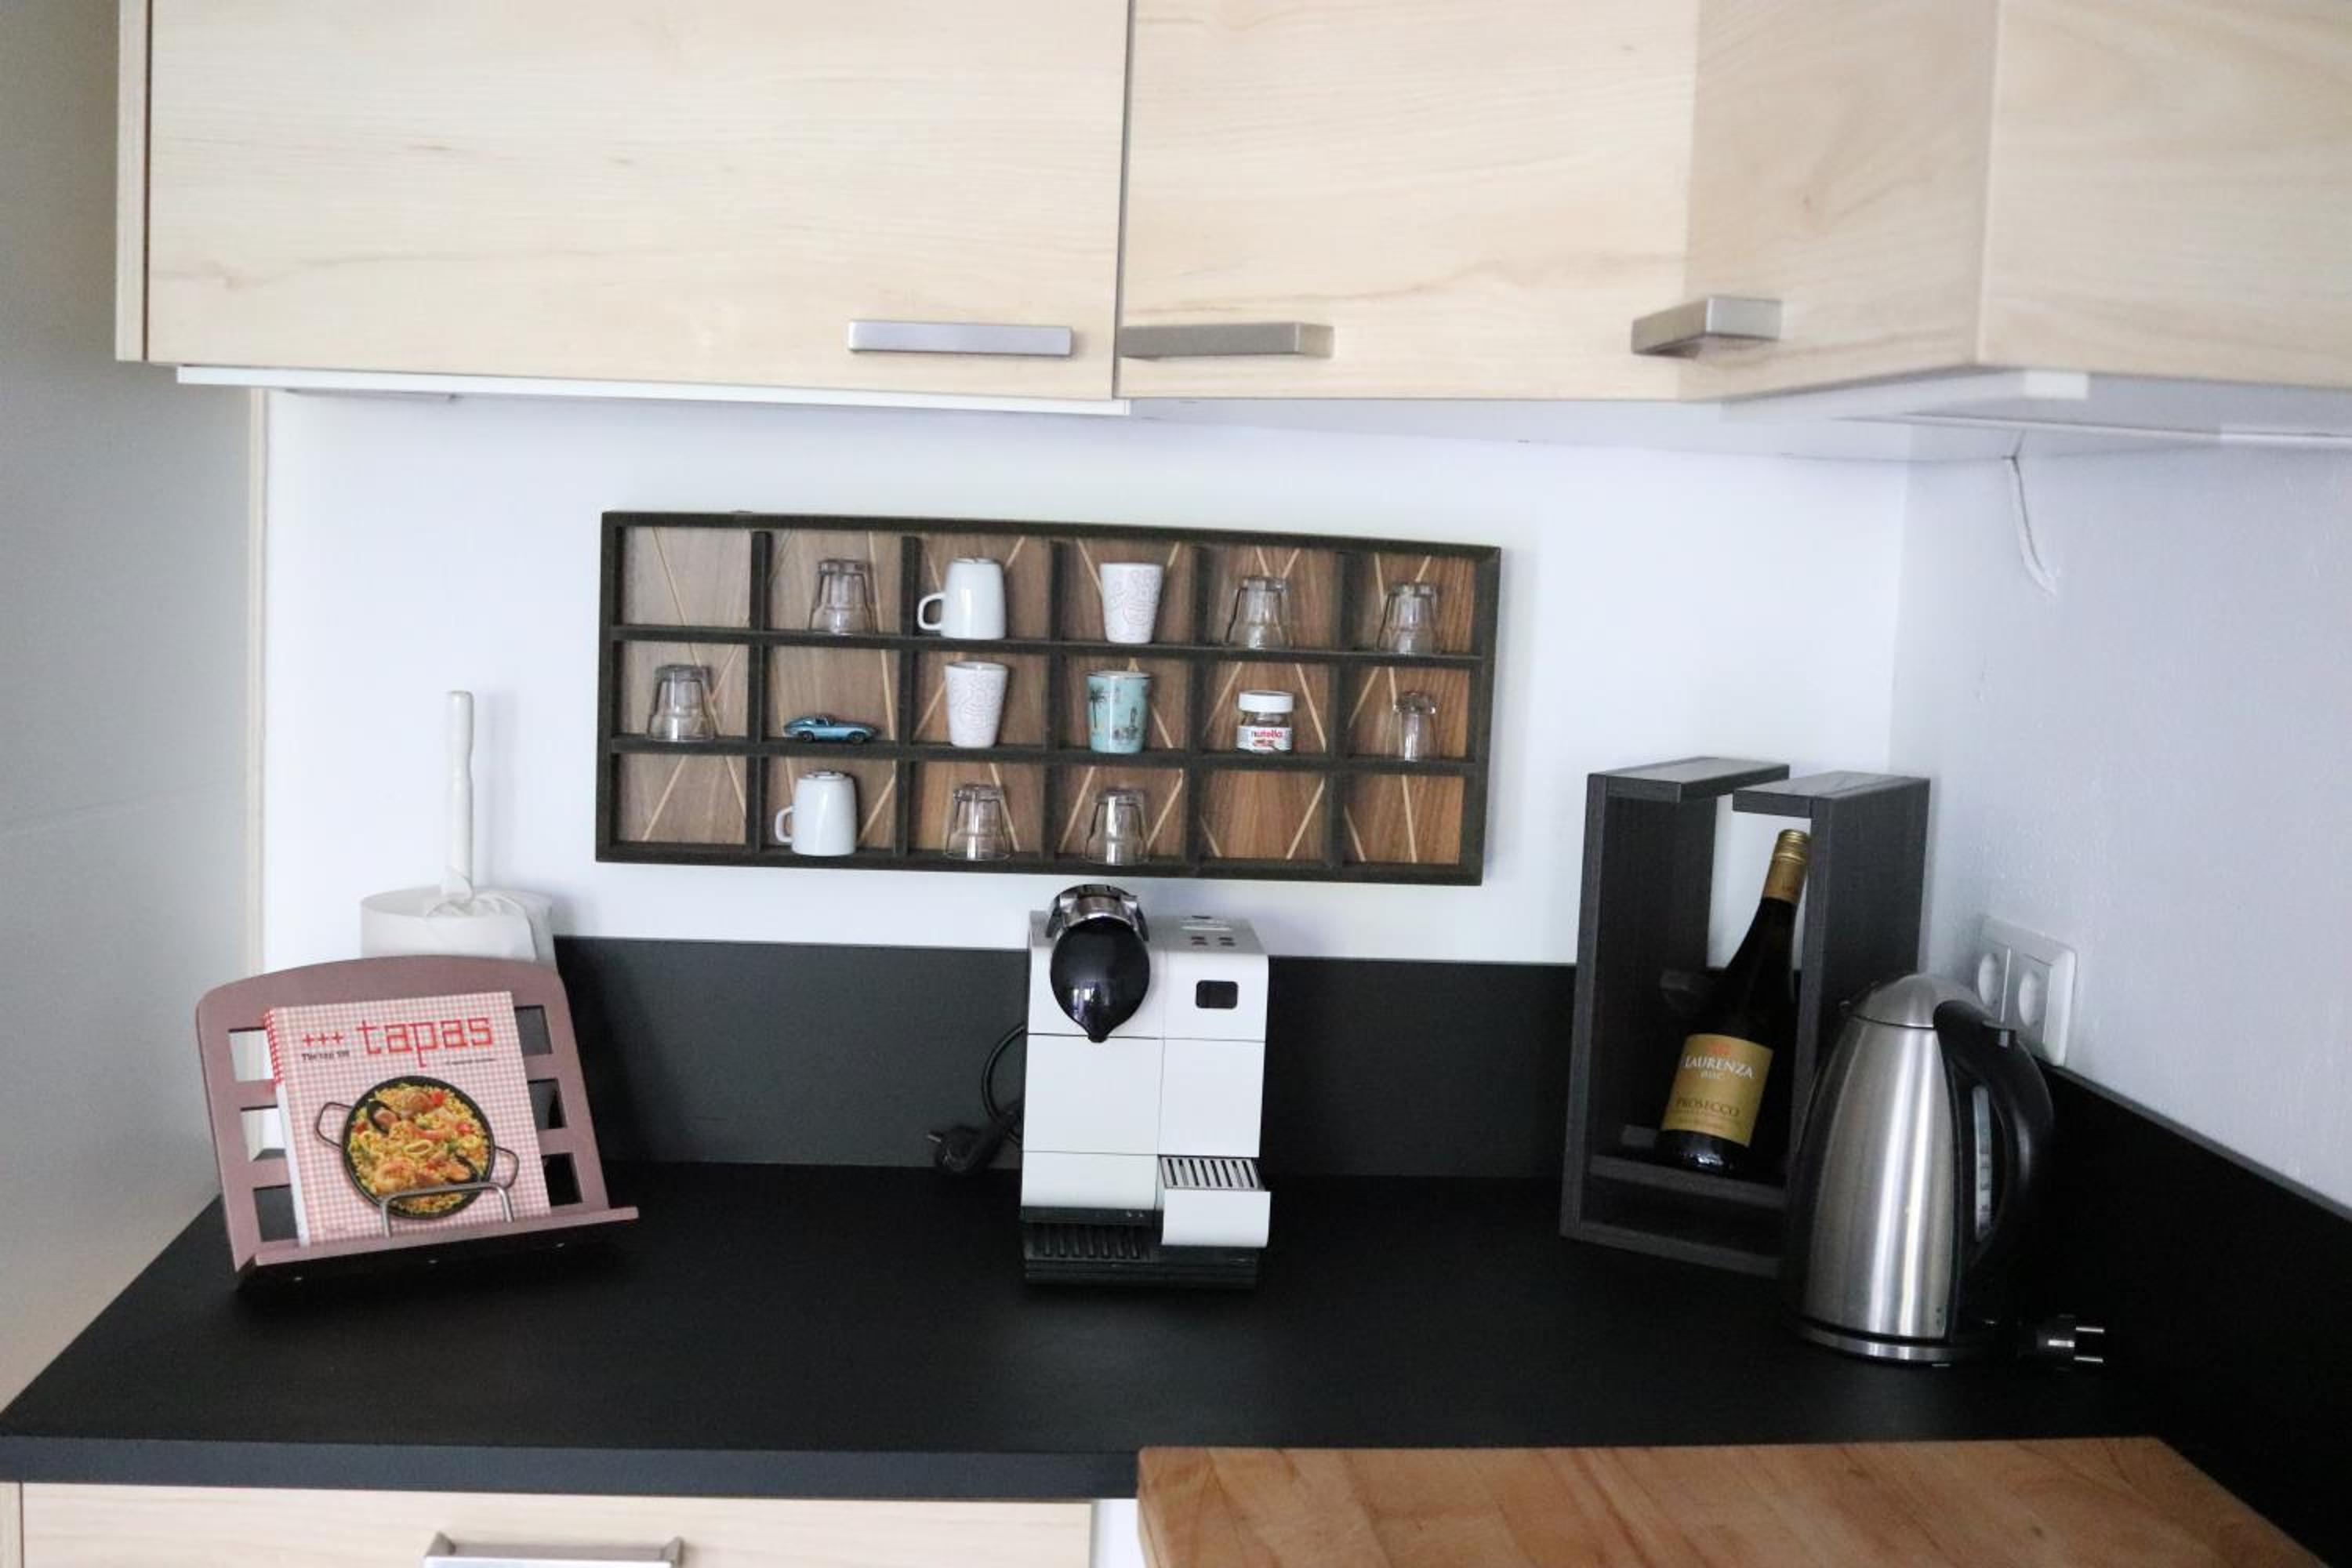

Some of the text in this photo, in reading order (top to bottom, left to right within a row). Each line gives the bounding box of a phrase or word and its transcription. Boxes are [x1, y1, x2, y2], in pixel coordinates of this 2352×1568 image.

[1251, 729, 1283, 738] nutella
[356, 1017, 493, 1068] tapas
[1681, 1055, 1754, 1080] LAURENZA
